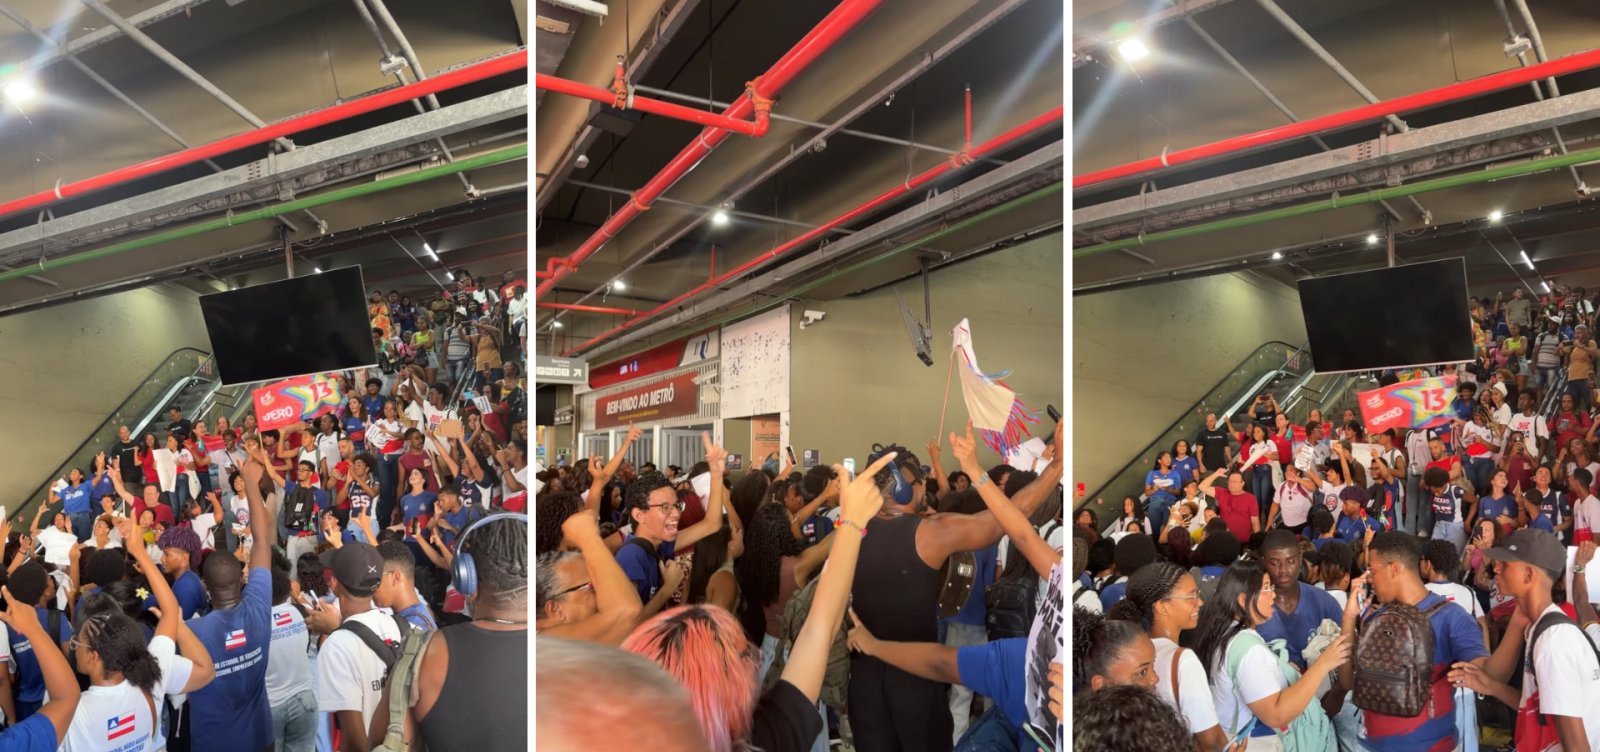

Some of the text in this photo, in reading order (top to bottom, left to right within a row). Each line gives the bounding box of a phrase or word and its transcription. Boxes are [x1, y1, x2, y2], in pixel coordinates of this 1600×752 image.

[310, 382, 333, 403] 13
[606, 396, 638, 415] BEM-VINDO
[638, 392, 649, 409] AO
[649, 382, 674, 406] METRÔ
[1421, 388, 1446, 411] 13
[350, 495, 370, 508] 25
[372, 680, 382, 691] ED
